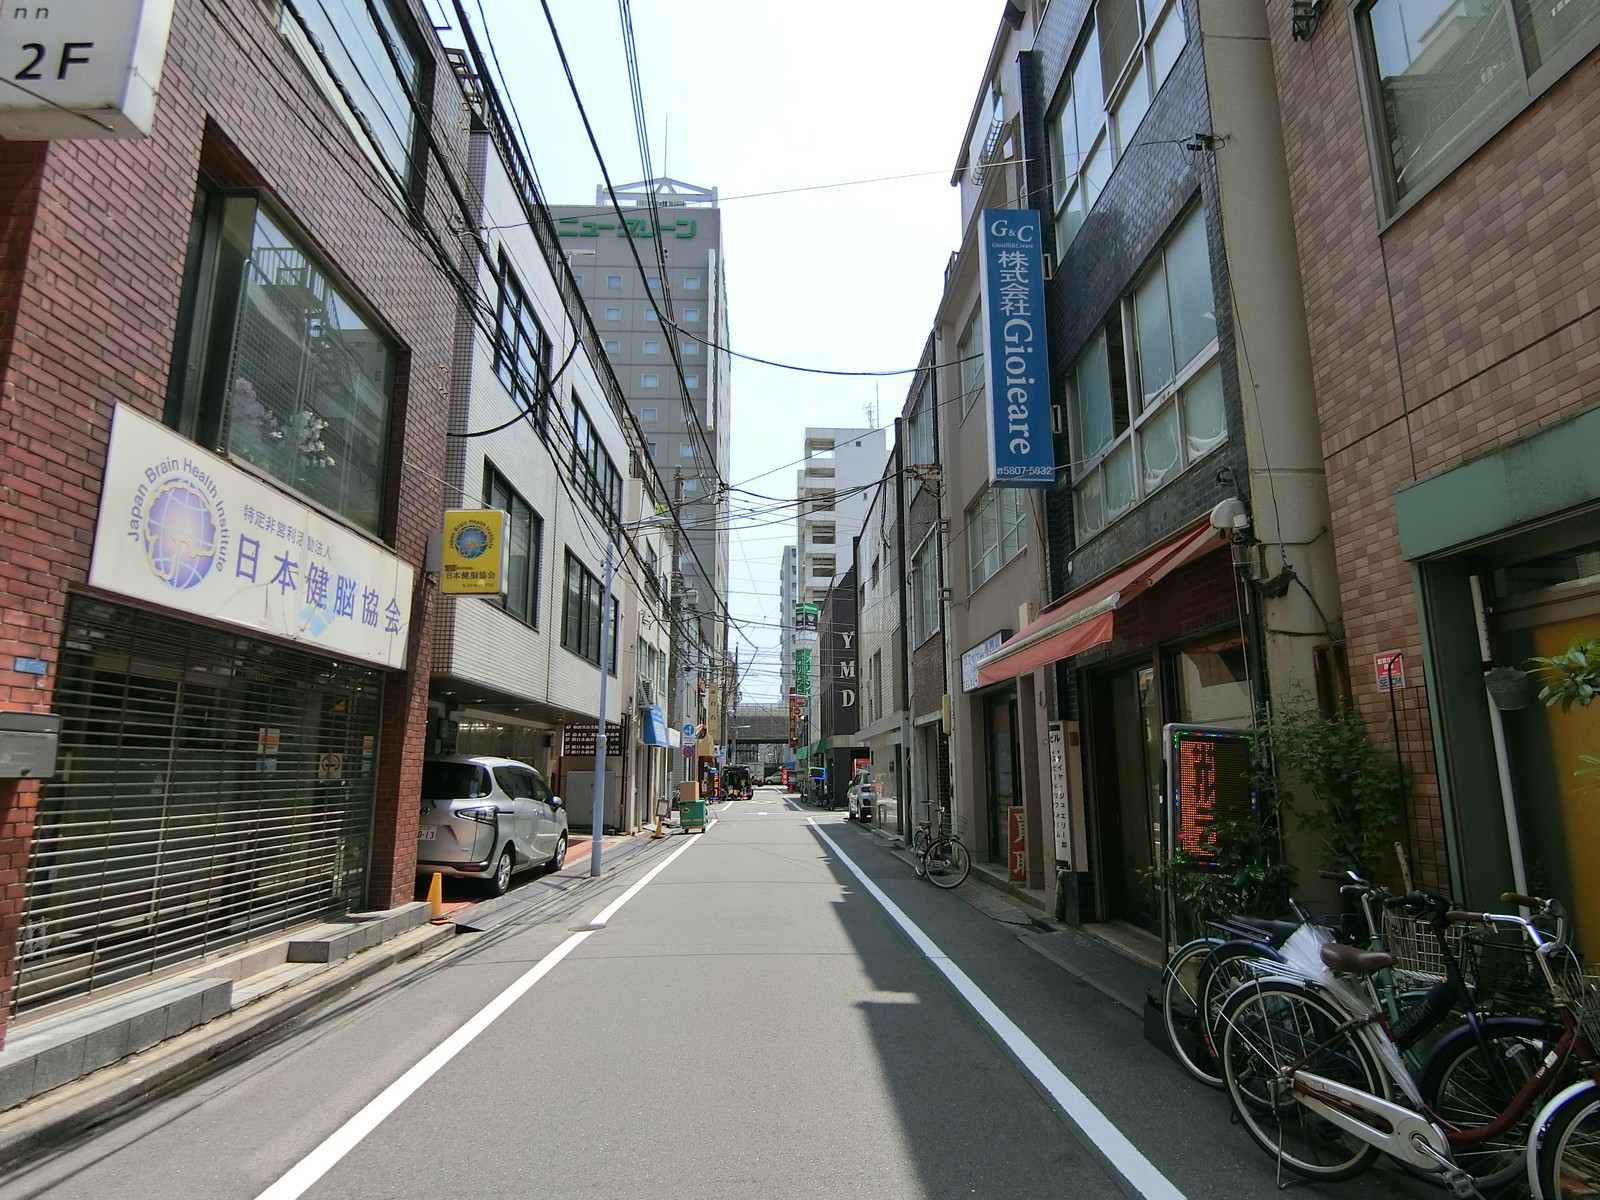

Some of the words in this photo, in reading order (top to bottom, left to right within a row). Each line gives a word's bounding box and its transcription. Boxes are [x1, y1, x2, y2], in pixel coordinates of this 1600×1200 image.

[14, 42, 94, 80] 2F
[558, 216, 697, 239] ニューグリーン
[991, 219, 1034, 242] G&C
[127, 484, 149, 542] Japan
[144, 456, 180, 484] Brain
[183, 457, 218, 499] Health
[215, 500, 230, 572] Institute
[449, 533, 457, 550] Japan
[454, 520, 468, 532] Brain
[469, 519, 486, 528] Health
[236, 532, 402, 635] 日本健脳協会
[1379, 676, 1403, 688] SEOM
